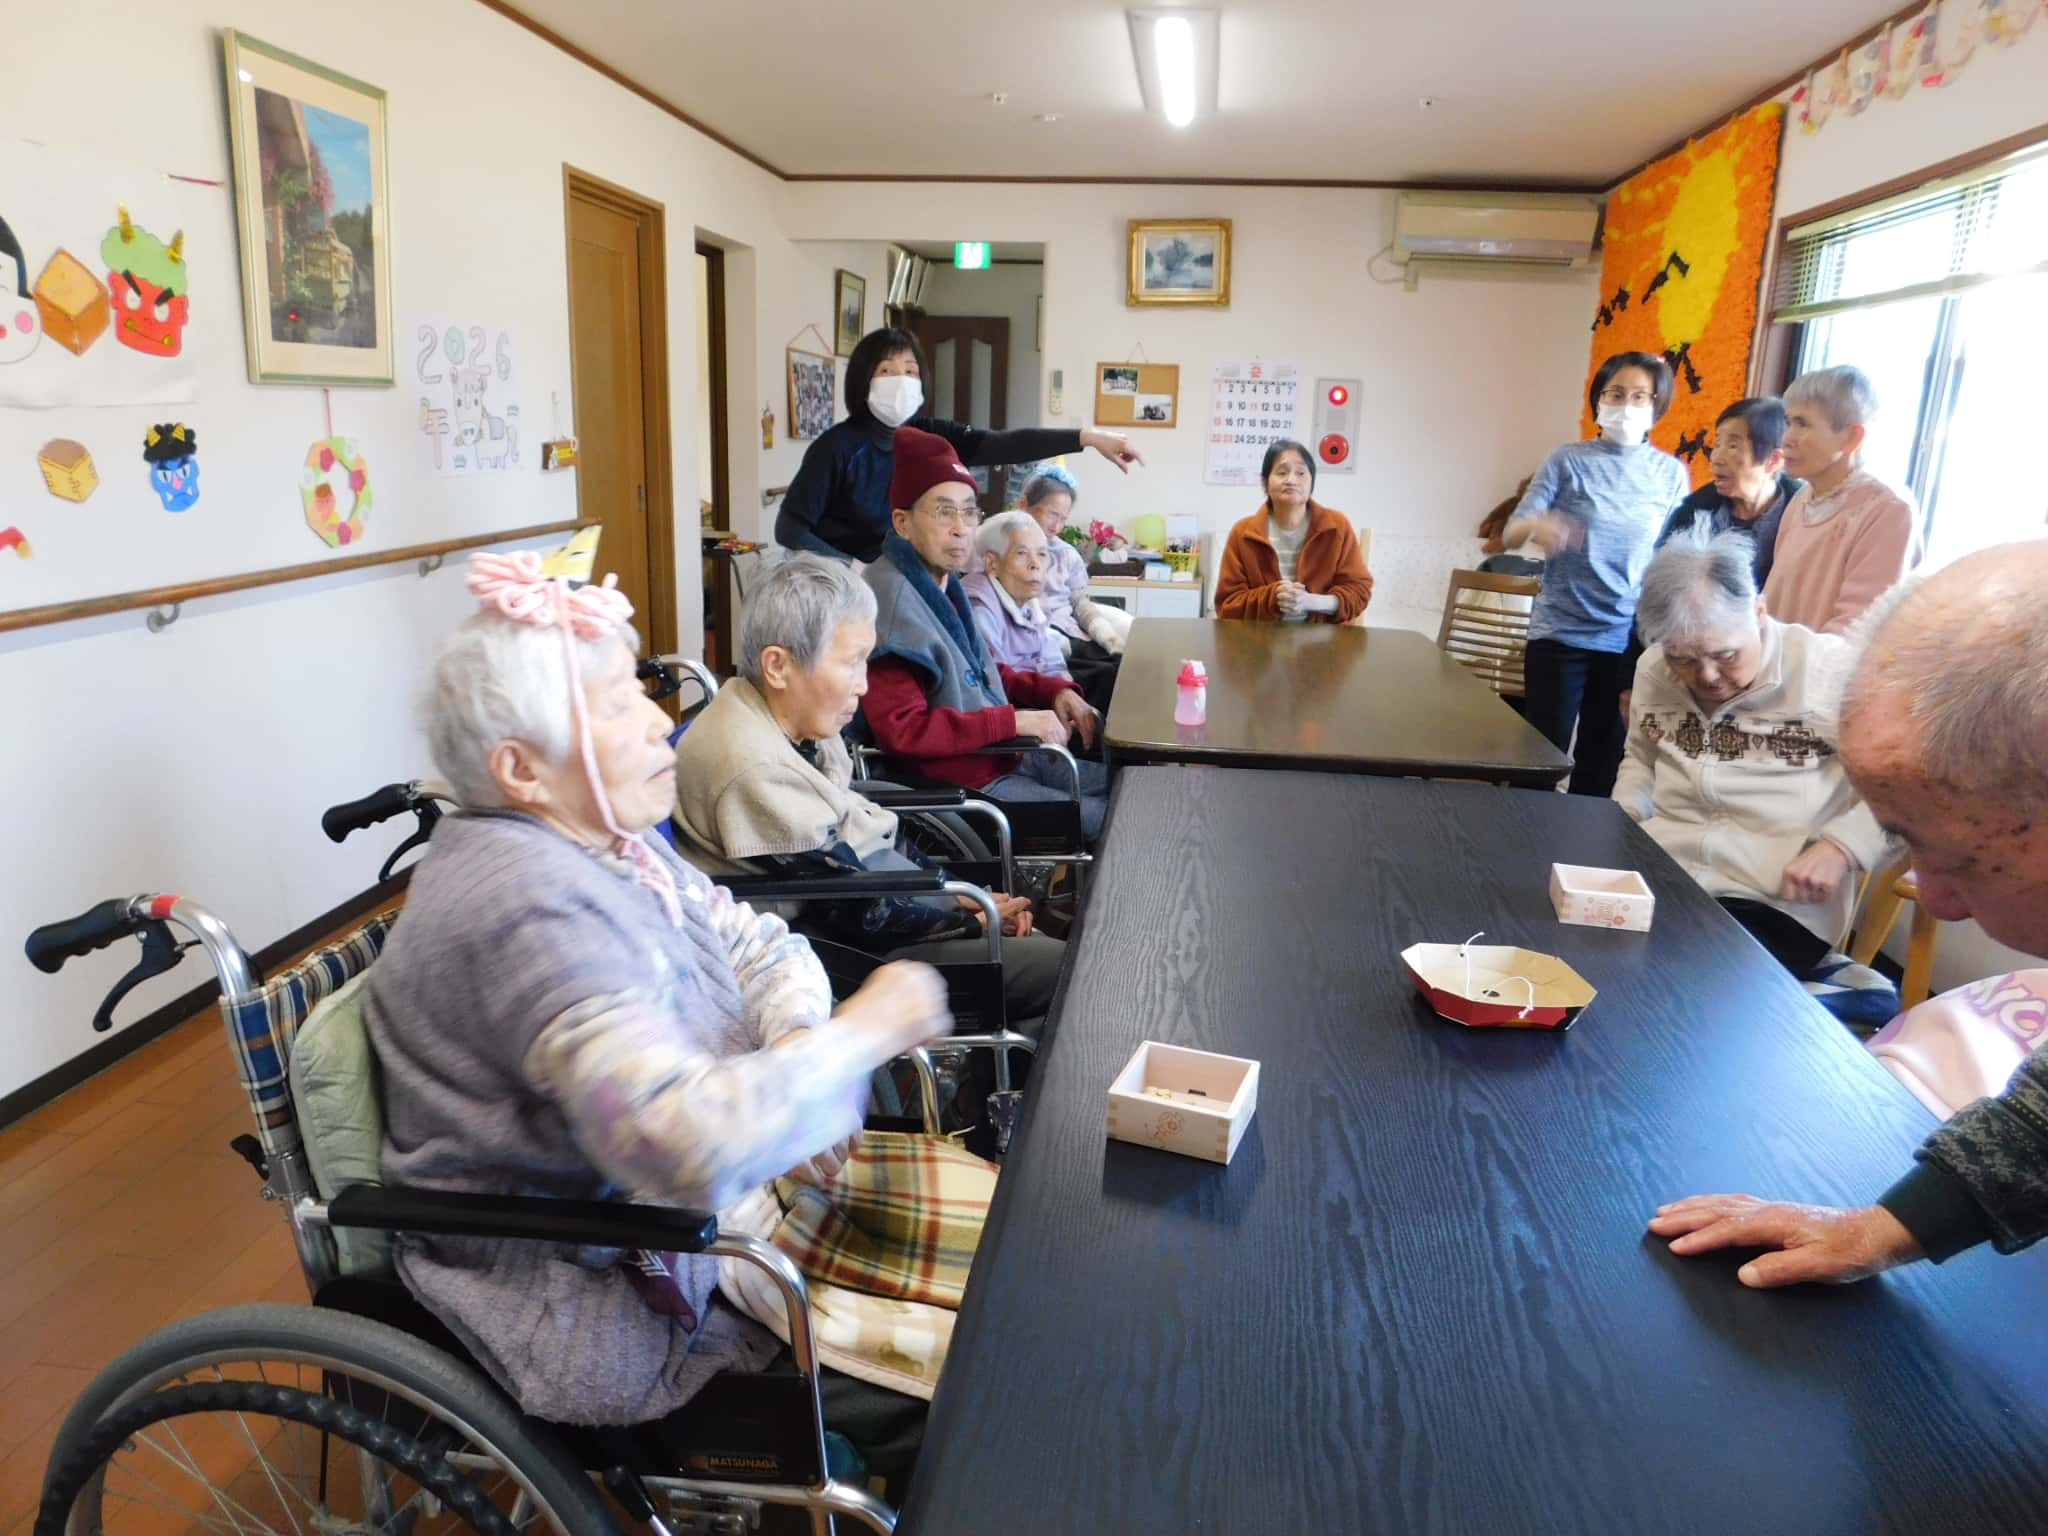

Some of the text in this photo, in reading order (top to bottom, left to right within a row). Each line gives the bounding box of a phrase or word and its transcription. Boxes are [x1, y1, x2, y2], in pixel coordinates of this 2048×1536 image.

[417, 324, 511, 384] 2026
[1238, 401, 1246, 410] 10
[1261, 402, 1269, 411] 12
[1285, 404, 1293, 412] 14
[1225, 418, 1233, 427] 16
[1237, 418, 1245, 428] 17
[1261, 419, 1269, 428] 19
[1271, 419, 1280, 428] 20
[1283, 420, 1291, 428] 21
[1234, 434, 1245, 444] 24
[1246, 435, 1256, 444] 25
[1258, 435, 1267, 444] 26
[710, 1456, 778, 1469] MATSUNAGA
